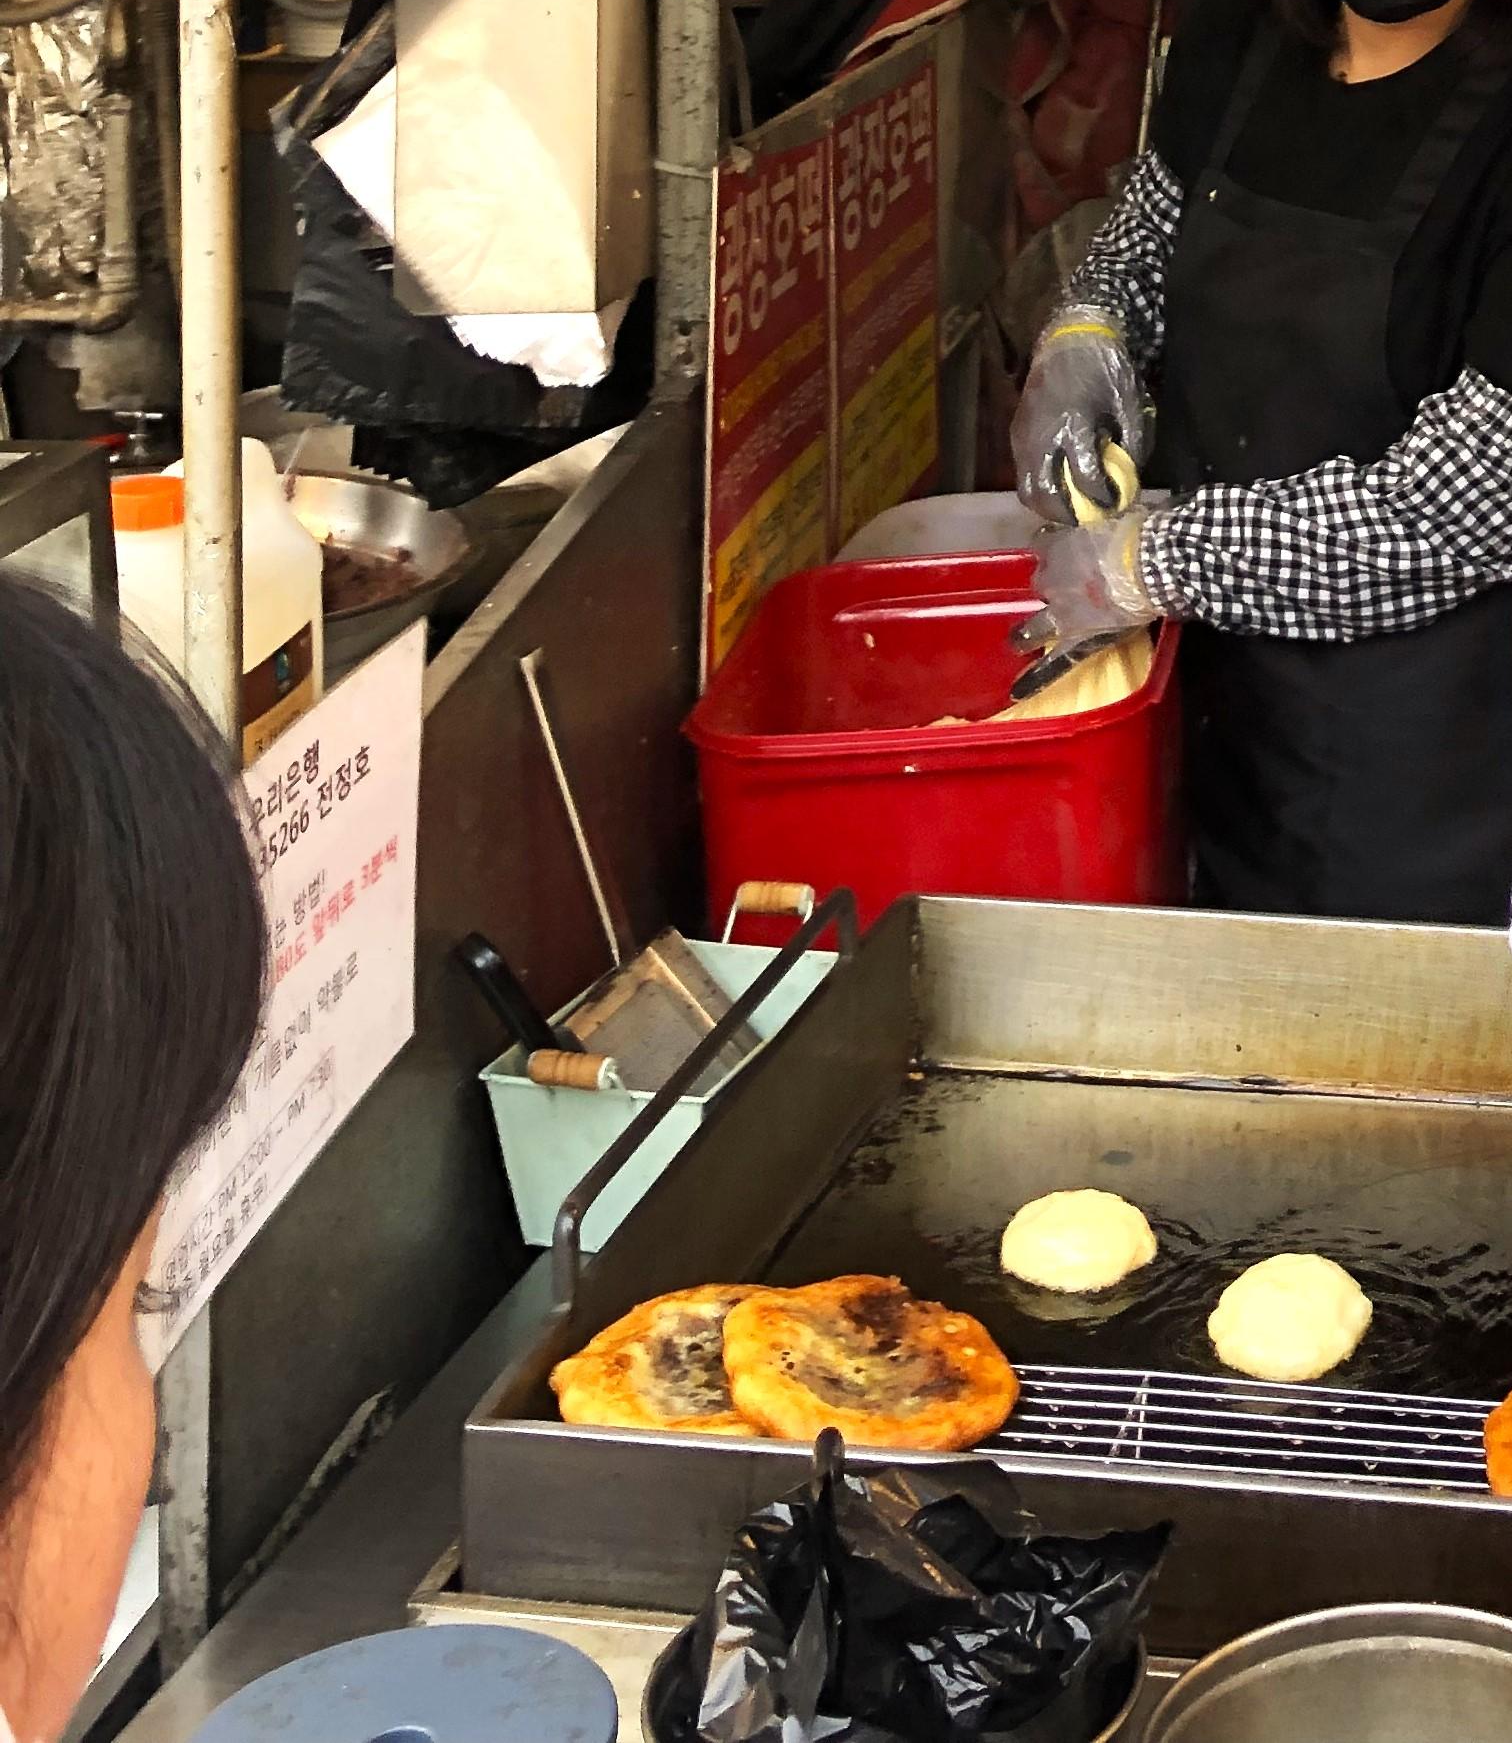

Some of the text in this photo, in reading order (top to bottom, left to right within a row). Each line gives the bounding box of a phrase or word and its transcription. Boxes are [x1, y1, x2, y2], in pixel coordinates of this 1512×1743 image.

[720, 141, 824, 356] 광장호떡
[838, 67, 933, 251] 광장호떡
[317, 745, 371, 819] 전정호
